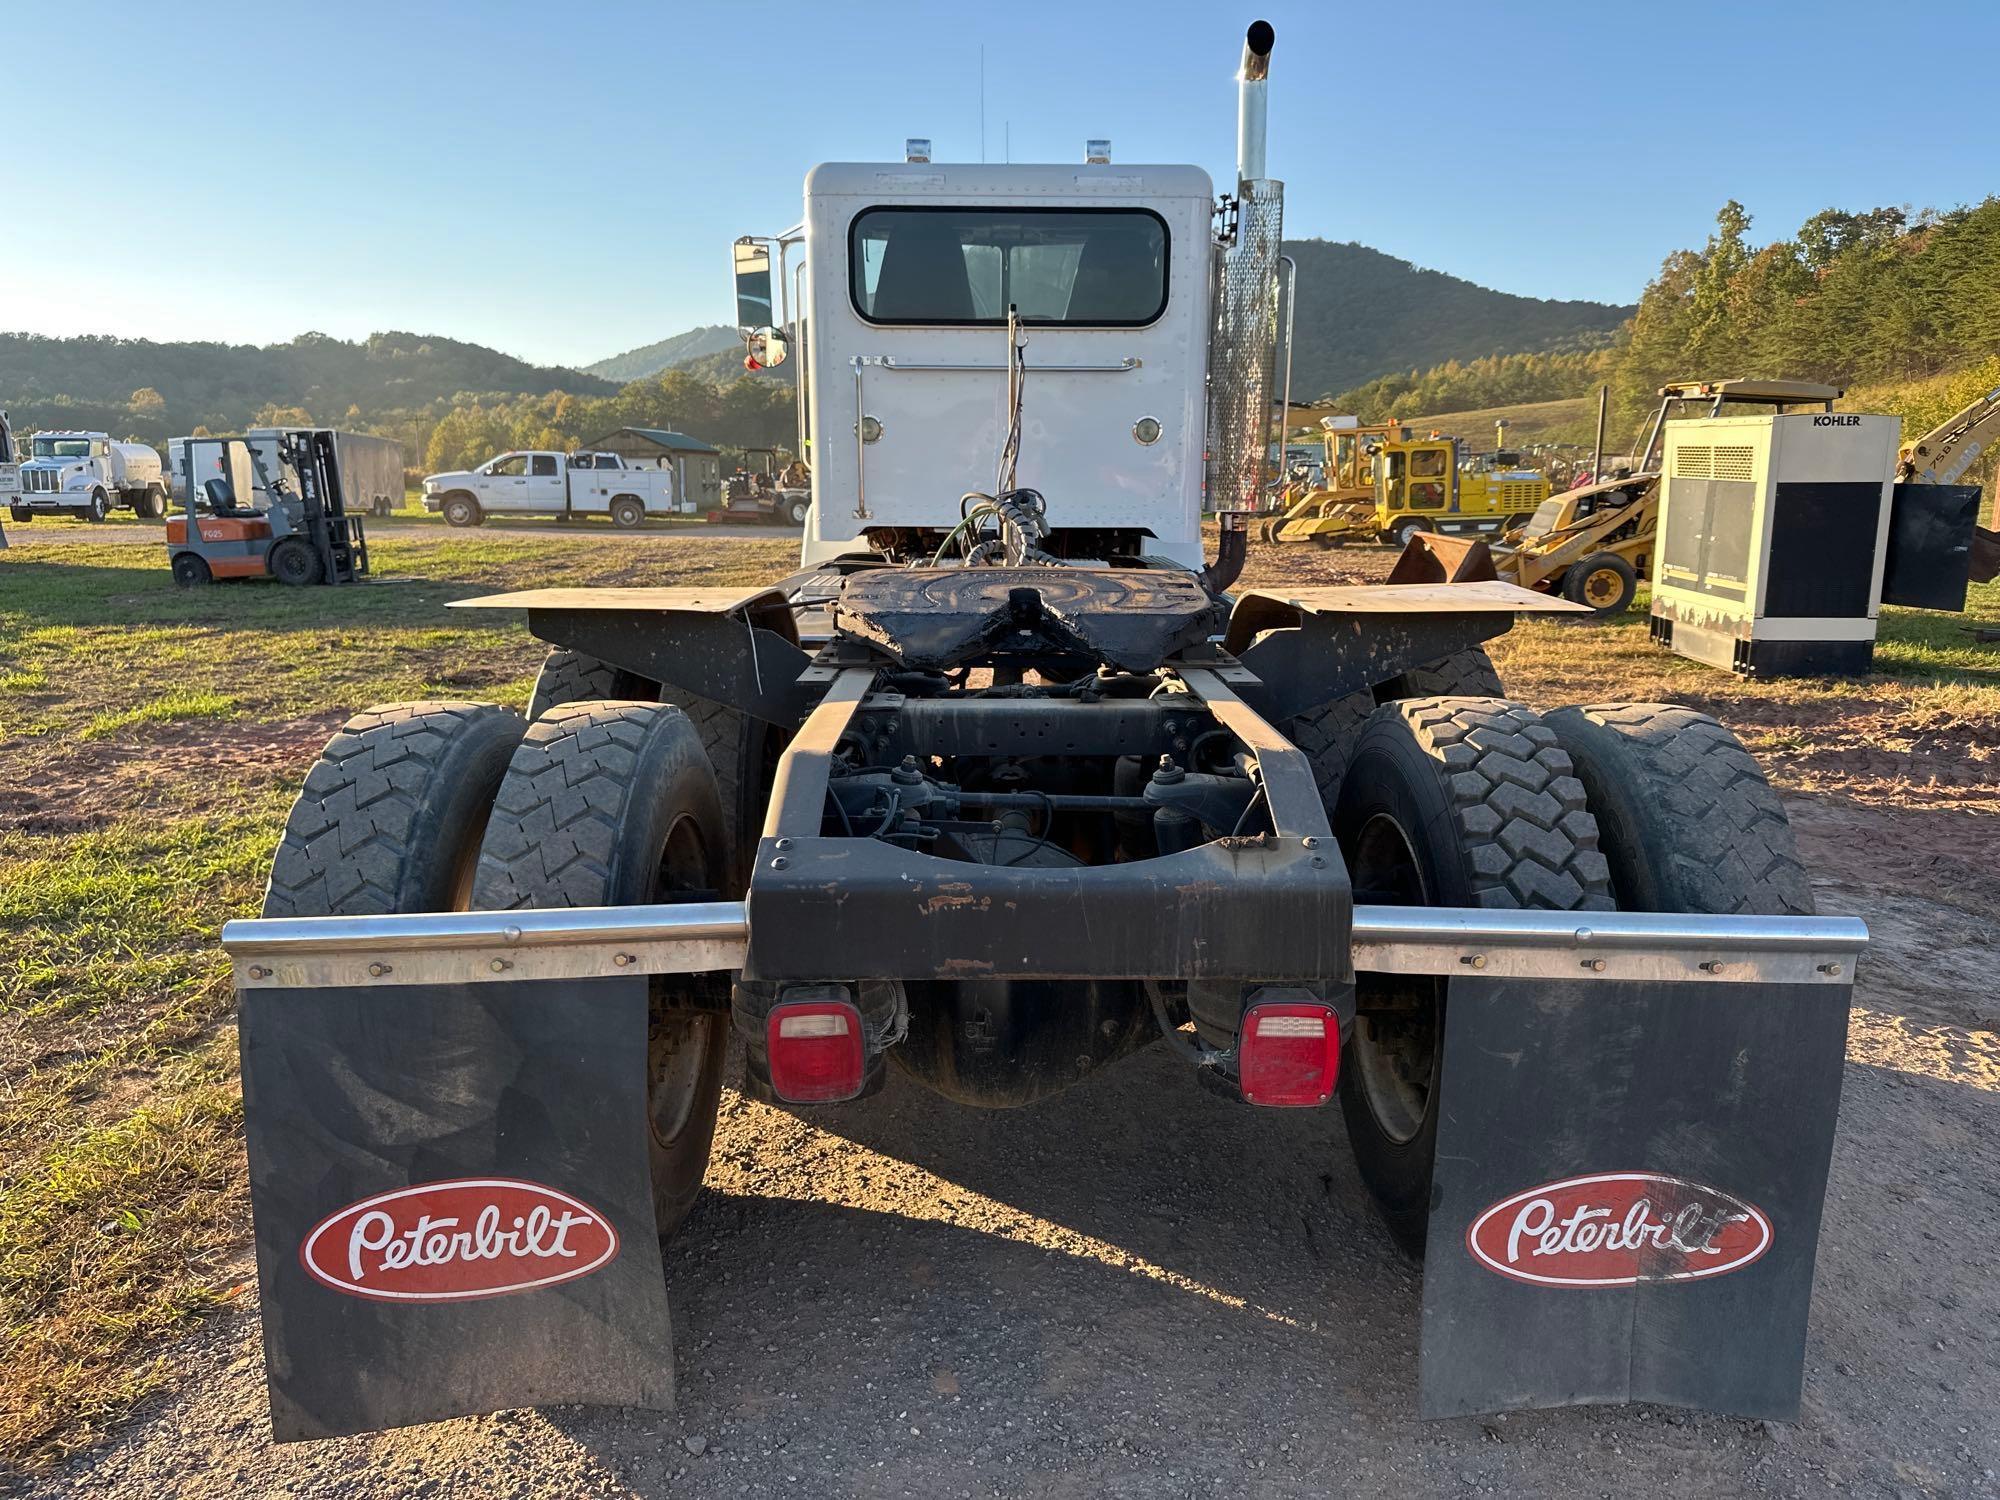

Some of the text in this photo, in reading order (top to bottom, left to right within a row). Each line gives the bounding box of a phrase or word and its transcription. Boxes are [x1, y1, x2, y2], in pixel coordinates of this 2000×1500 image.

[1813, 415, 1861, 427] KOHLER
[348, 1204, 593, 1282] Peterbilt
[1507, 1199, 1750, 1263] Peterbilt
